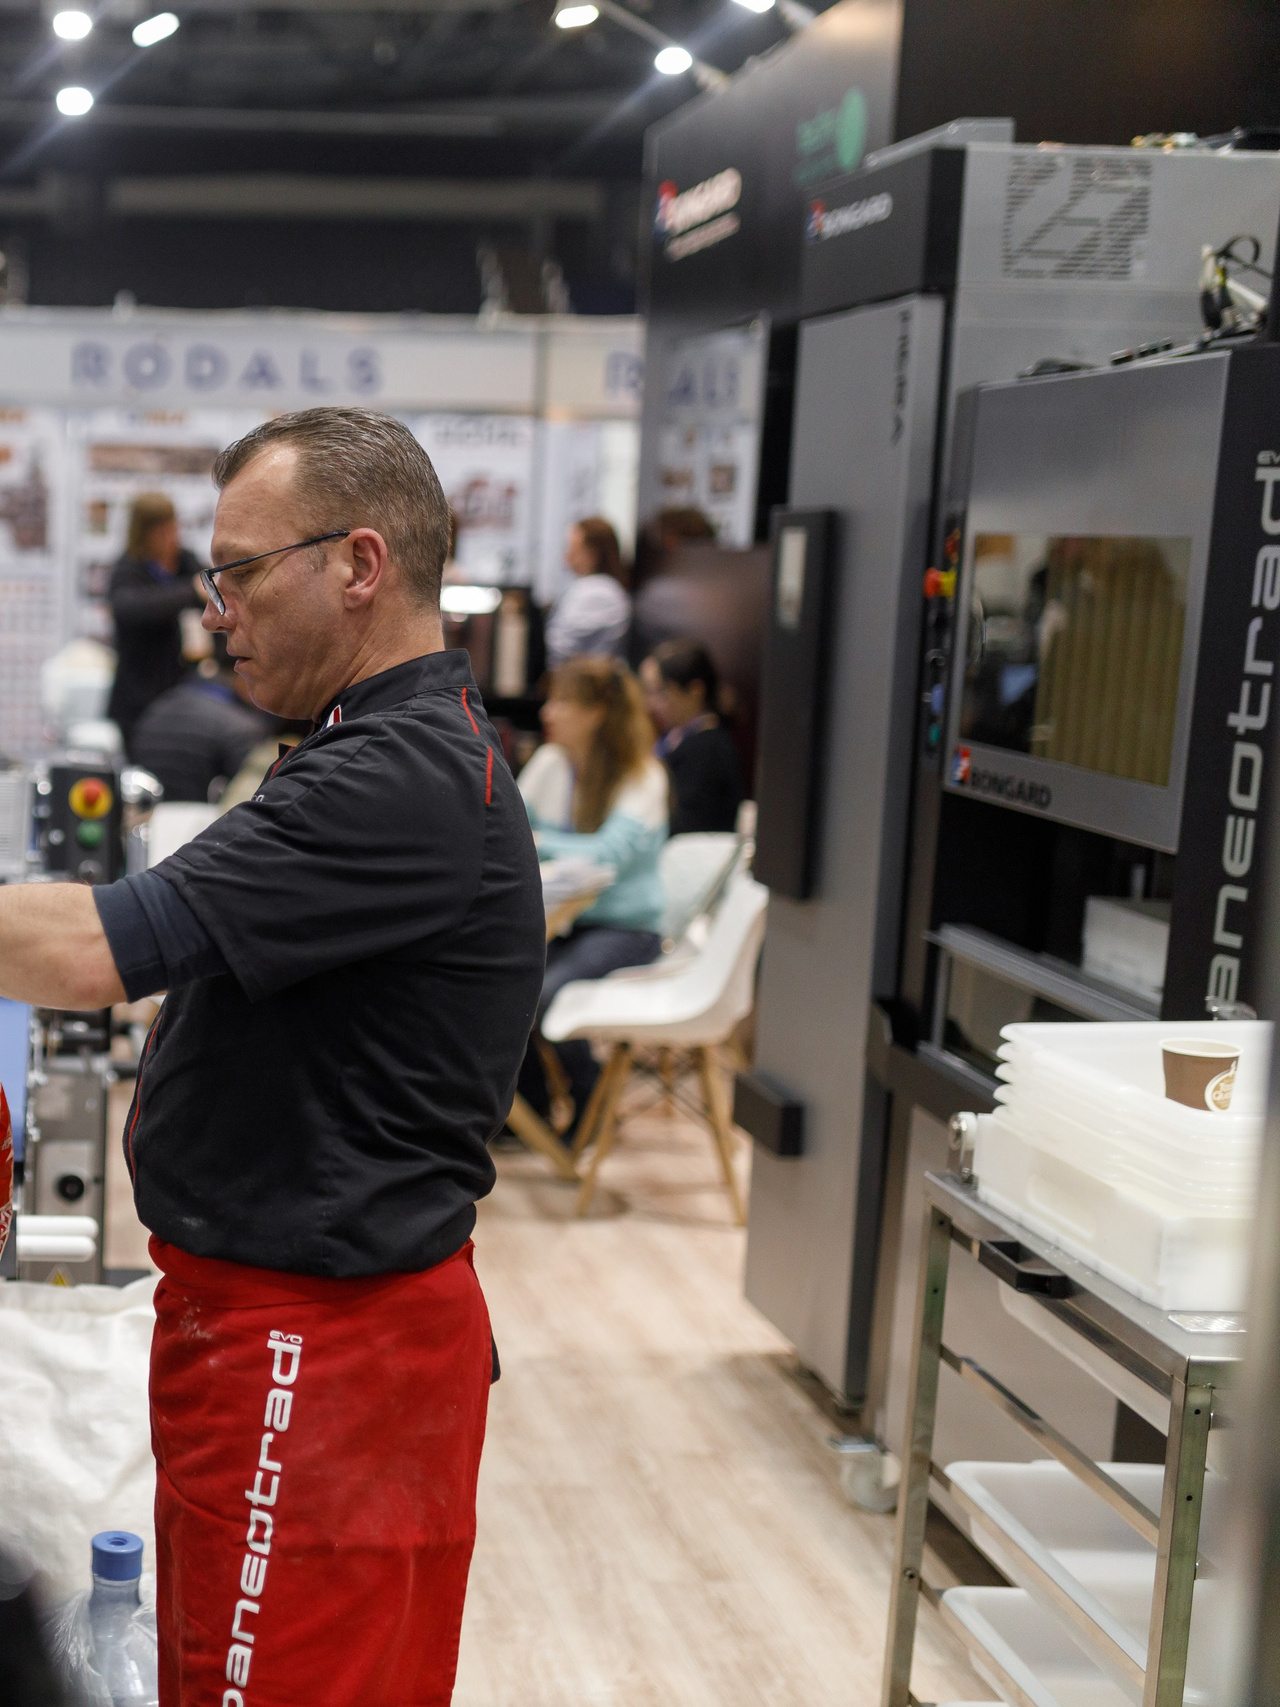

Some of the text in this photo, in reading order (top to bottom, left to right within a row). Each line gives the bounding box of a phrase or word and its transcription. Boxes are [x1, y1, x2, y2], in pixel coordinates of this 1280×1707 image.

[71, 342, 384, 393] RODALS
[1206, 466, 1280, 1008] aneotrad
[971, 766, 1053, 810] BONGARD
